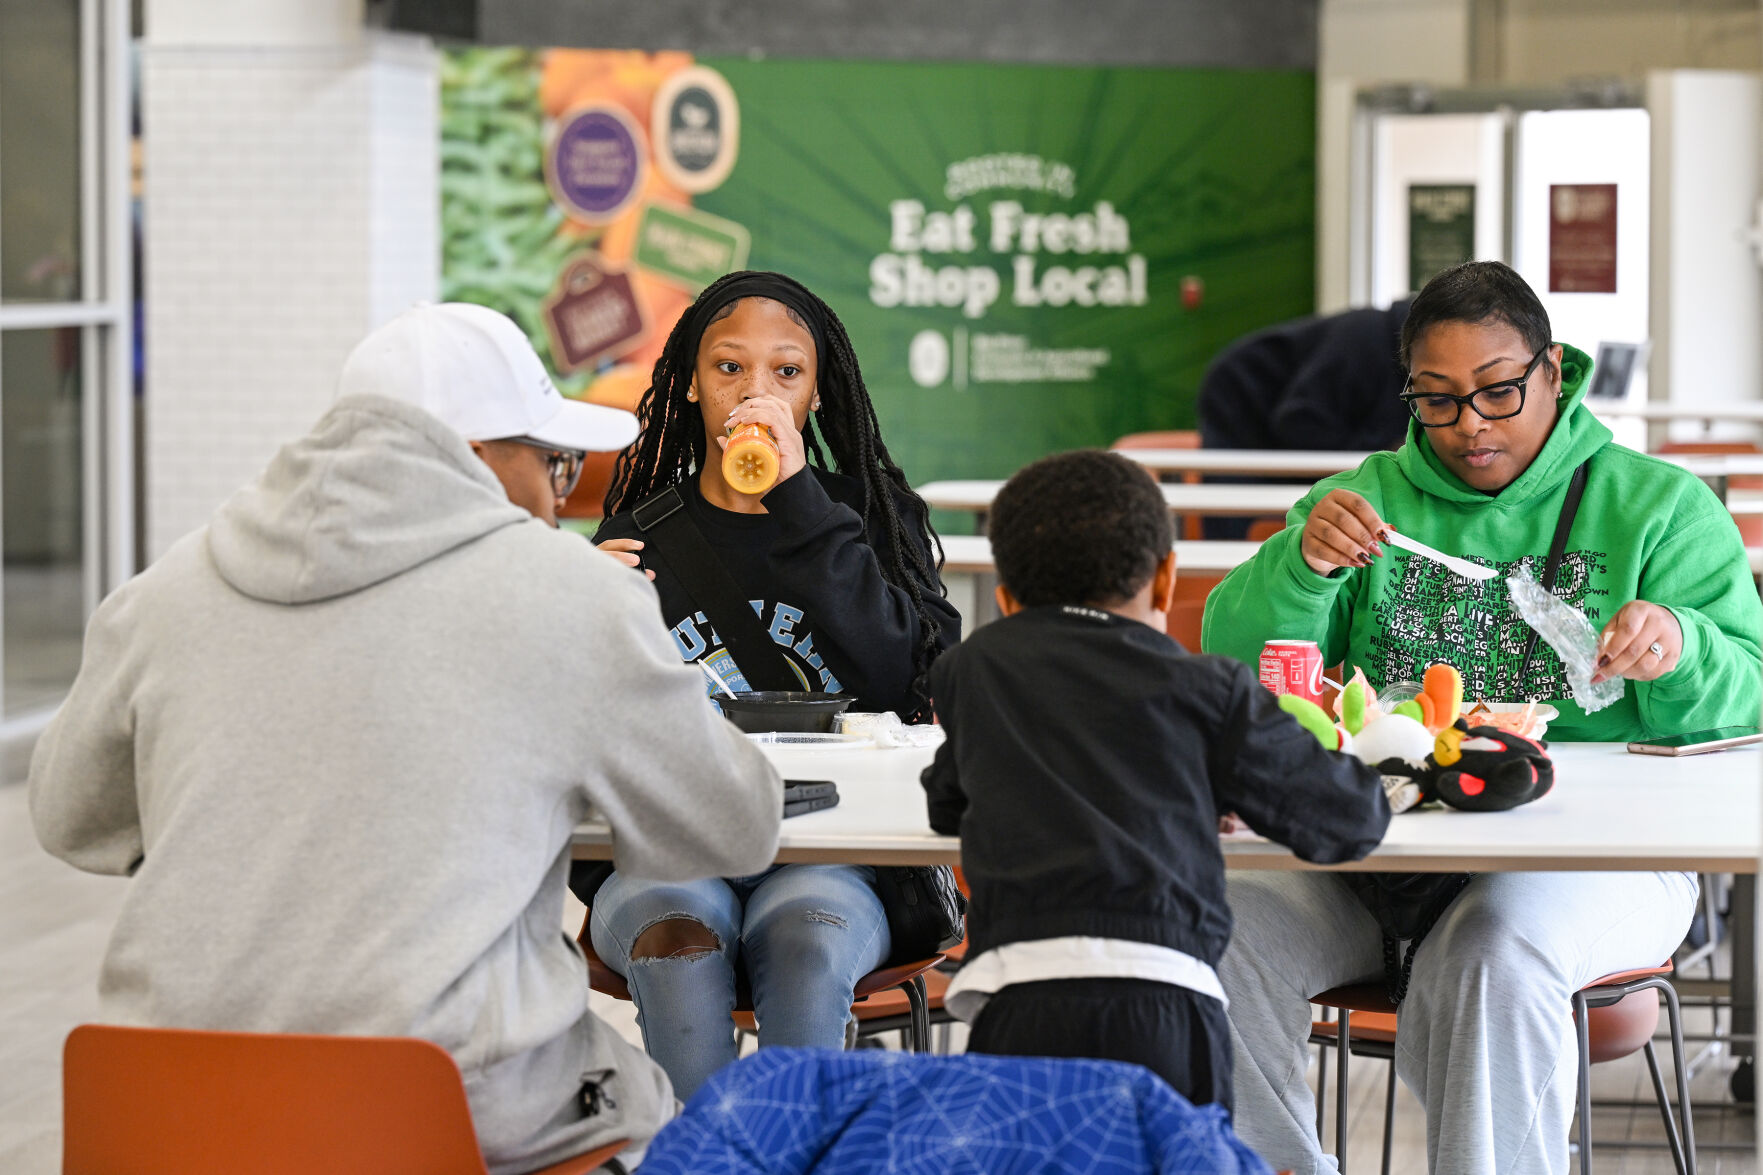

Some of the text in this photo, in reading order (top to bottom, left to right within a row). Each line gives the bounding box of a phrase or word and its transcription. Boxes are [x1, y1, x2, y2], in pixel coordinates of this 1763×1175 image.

[890, 199, 1130, 253] Eat Fresh
[869, 252, 1148, 318] Shop Local
